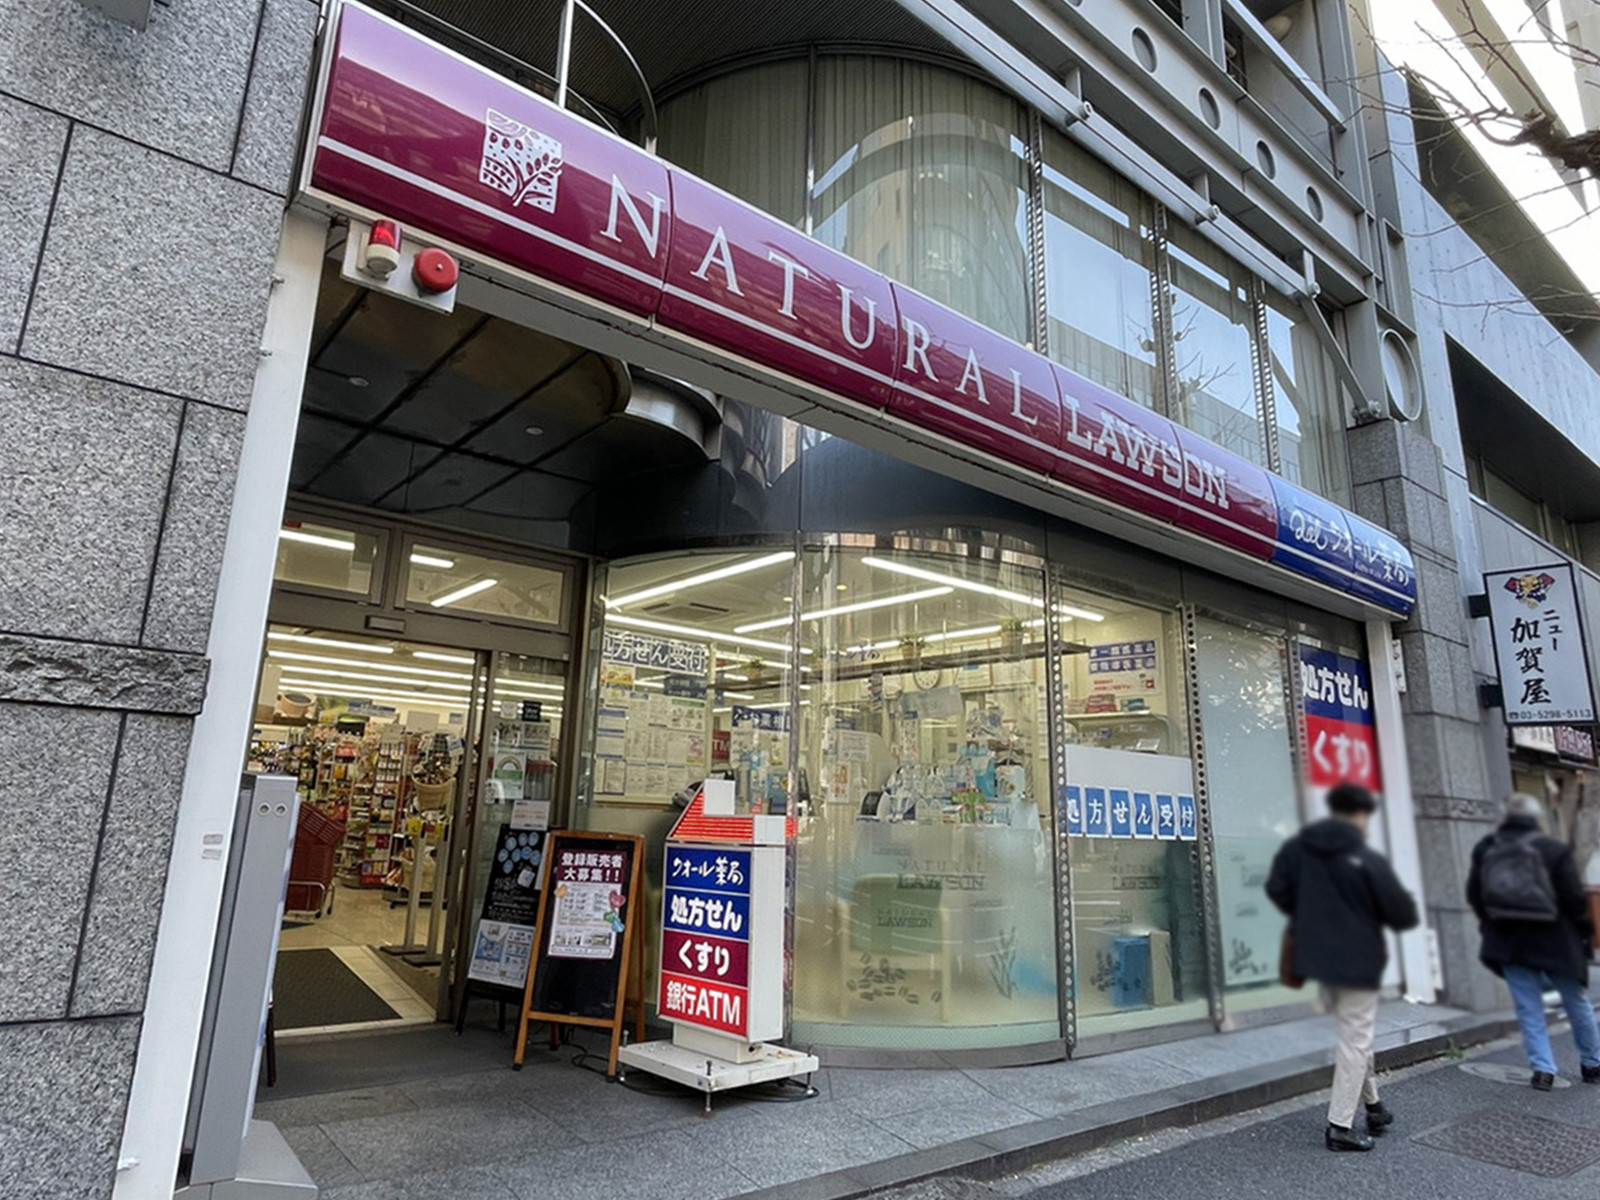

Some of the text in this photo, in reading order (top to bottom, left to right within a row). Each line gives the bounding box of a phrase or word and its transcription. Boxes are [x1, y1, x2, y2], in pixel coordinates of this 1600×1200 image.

[600, 173, 1229, 510] NATURAL LAWSON
[1543, 609, 1563, 651] ニュー
[1510, 617, 1552, 705] 加賀屋
[1301, 660, 1369, 711] 処方せん
[1313, 730, 1372, 780] くすり
[1067, 798, 1195, 828] 処方せん受付
[672, 856, 744, 886] クオール薬局
[670, 894, 743, 932] 処方せん
[678, 939, 730, 976] くすり
[666, 980, 741, 1026] 銀行ATM
